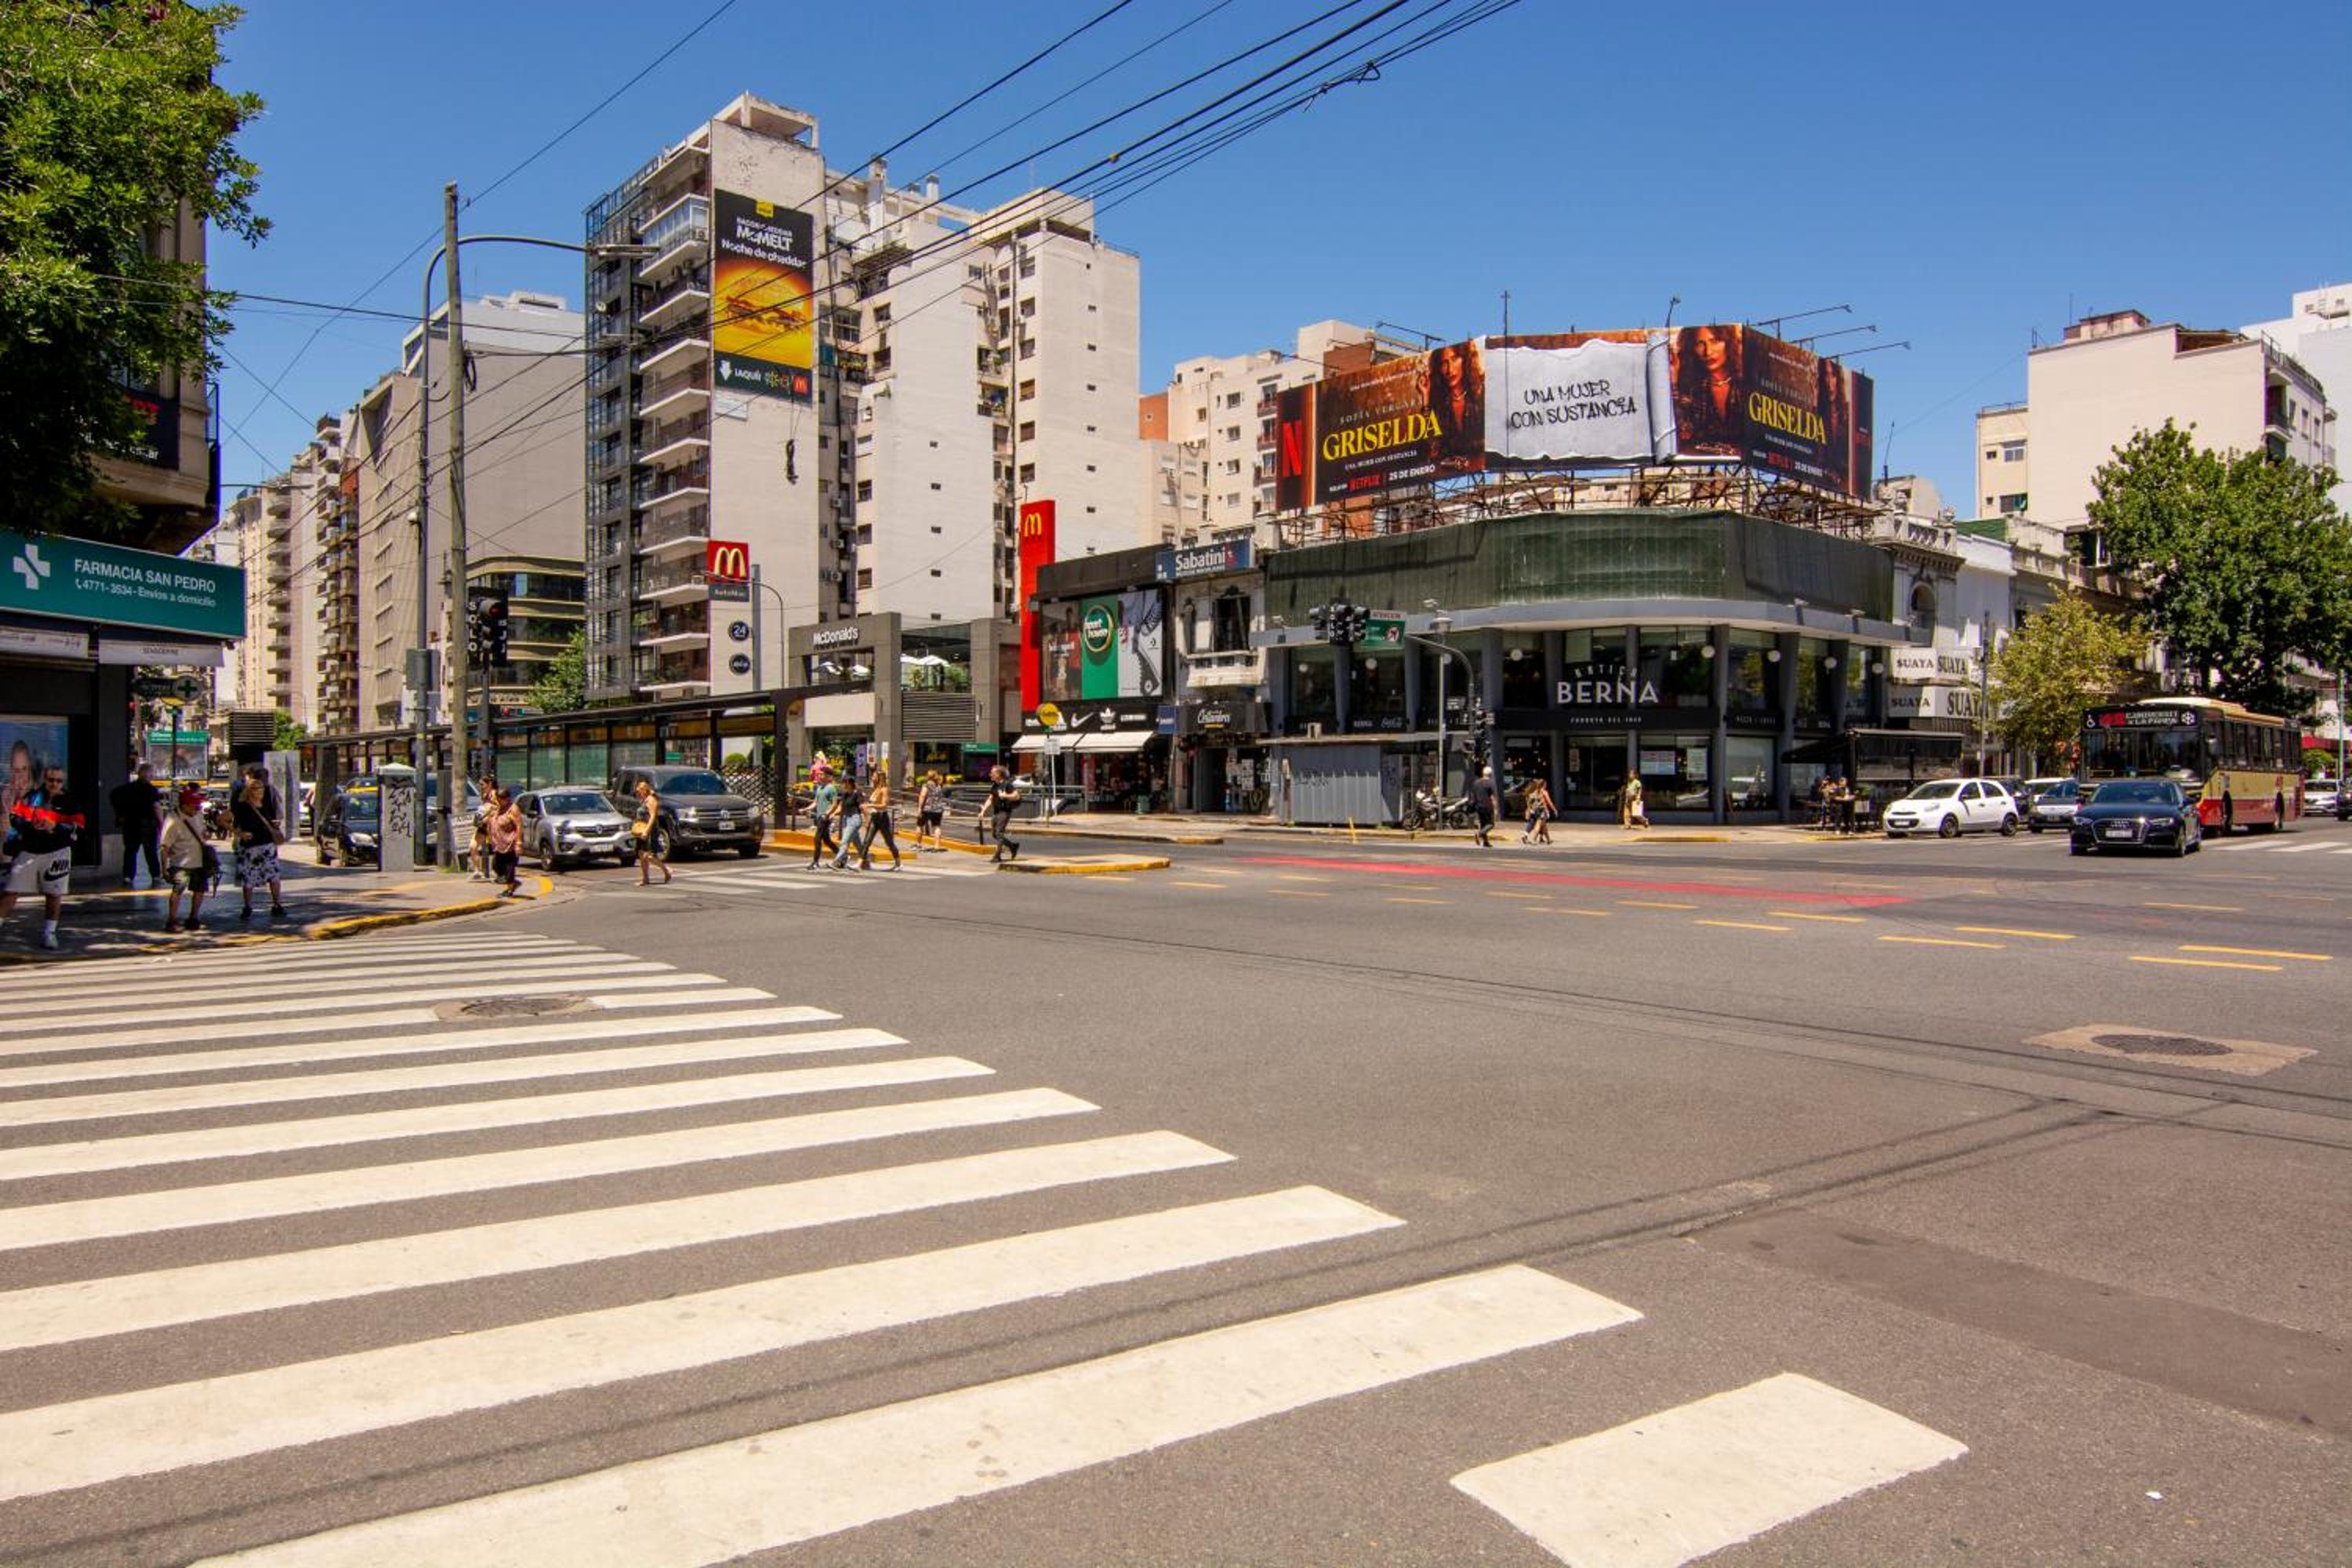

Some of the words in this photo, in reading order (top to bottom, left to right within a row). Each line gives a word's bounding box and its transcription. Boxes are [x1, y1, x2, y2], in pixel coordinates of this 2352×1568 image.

[722, 238, 753, 257] Noche
[754, 248, 767, 260] de
[1524, 387, 1554, 405] UNA
[1558, 379, 1611, 401] MUJER
[1510, 411, 1544, 430] CON
[1545, 396, 1638, 424] SUSTANCIA
[1748, 391, 1827, 445] GRISELDA
[1322, 408, 1443, 461] GRISELDA
[1348, 474, 1381, 491] NETFLIX
[1399, 470, 1409, 479] DE
[1410, 464, 1436, 477] ENERO
[1175, 546, 1226, 570] Sabatini
[74, 559, 143, 583] FARMACIA
[145, 569, 172, 587] SAN
[174, 575, 216, 593] PEDRO
[177, 593, 216, 608] domicilio
[733, 625, 746, 634] 24
[813, 626, 858, 645] McDonald's
[1896, 658, 1934, 669] SUAYA
[1937, 655, 1969, 675] SUAYA
[1557, 680, 1659, 703] BERNA
[1891, 697, 1930, 707] SUAYA
